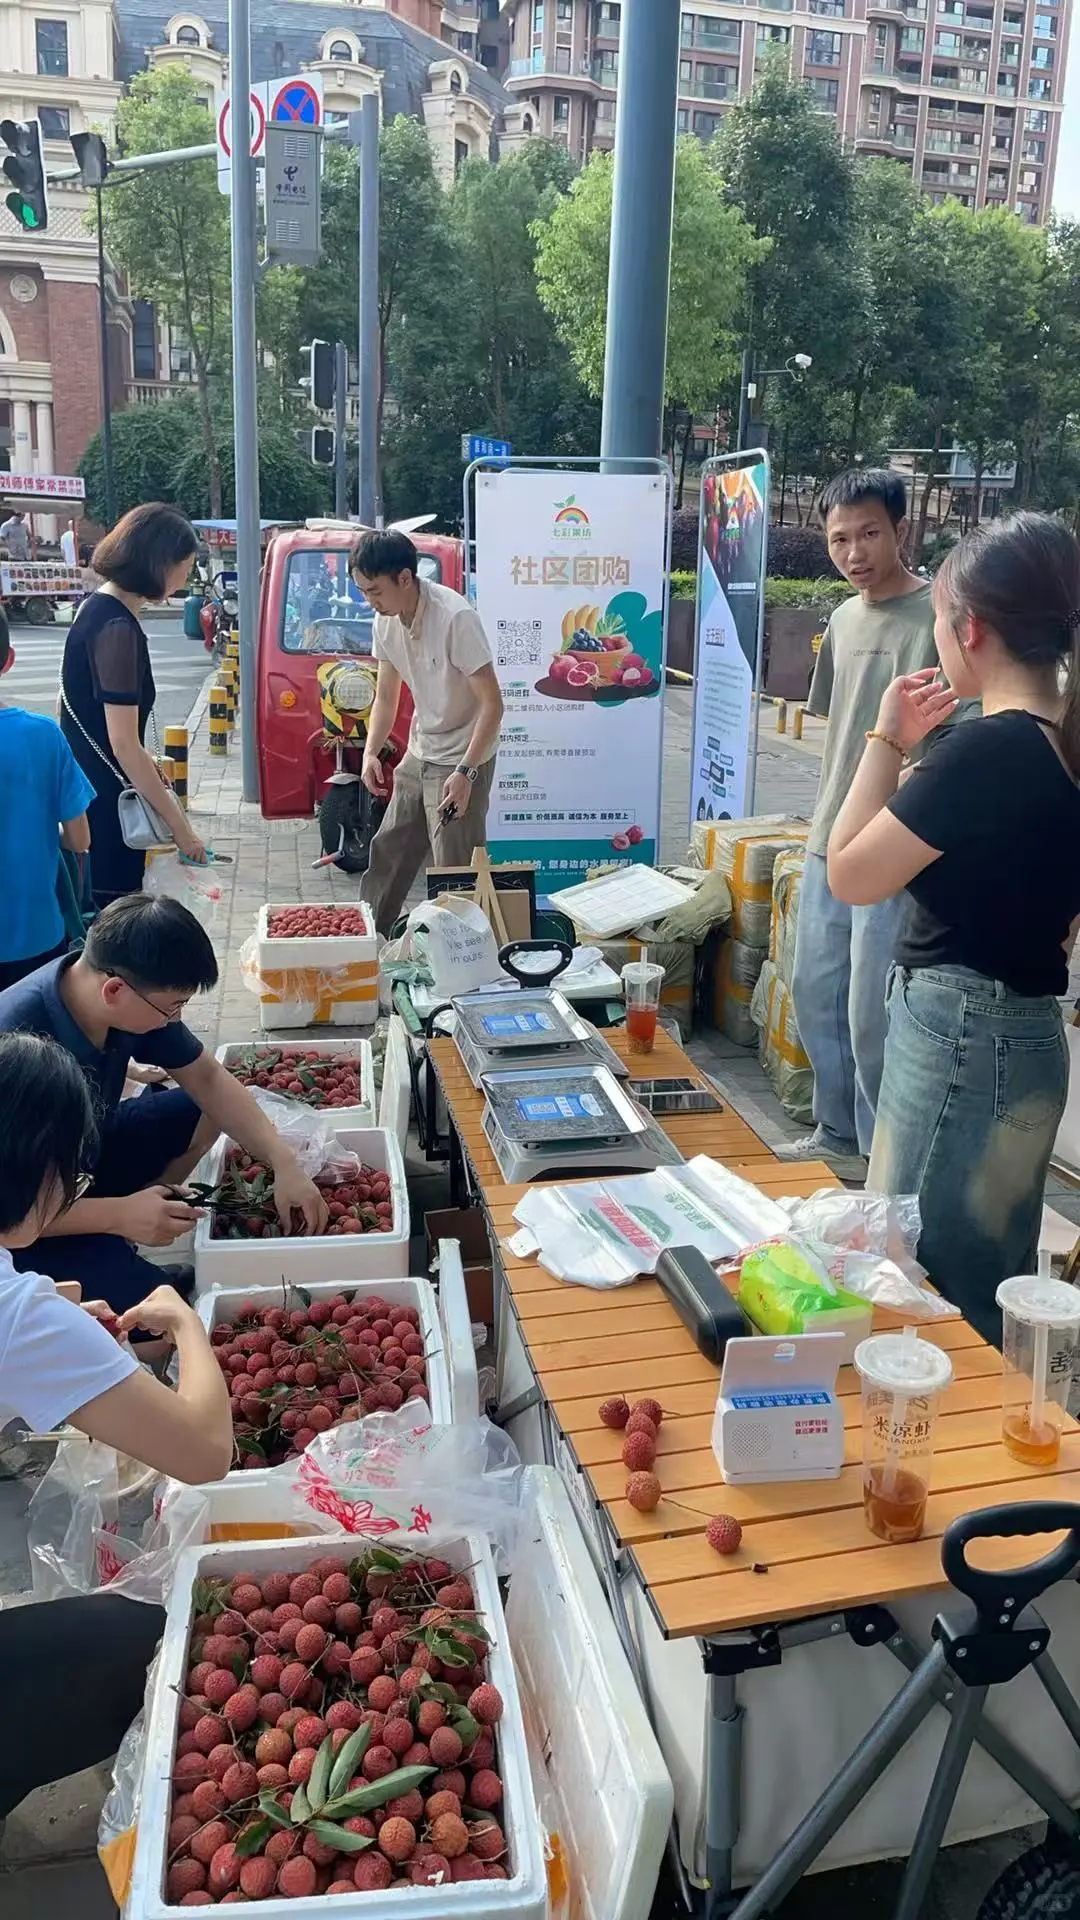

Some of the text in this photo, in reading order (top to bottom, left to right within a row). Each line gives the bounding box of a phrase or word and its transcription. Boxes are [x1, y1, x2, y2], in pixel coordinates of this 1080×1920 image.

[510, 555, 630, 586] 社区团购
[873, 1416, 931, 1438] 米凉虾
